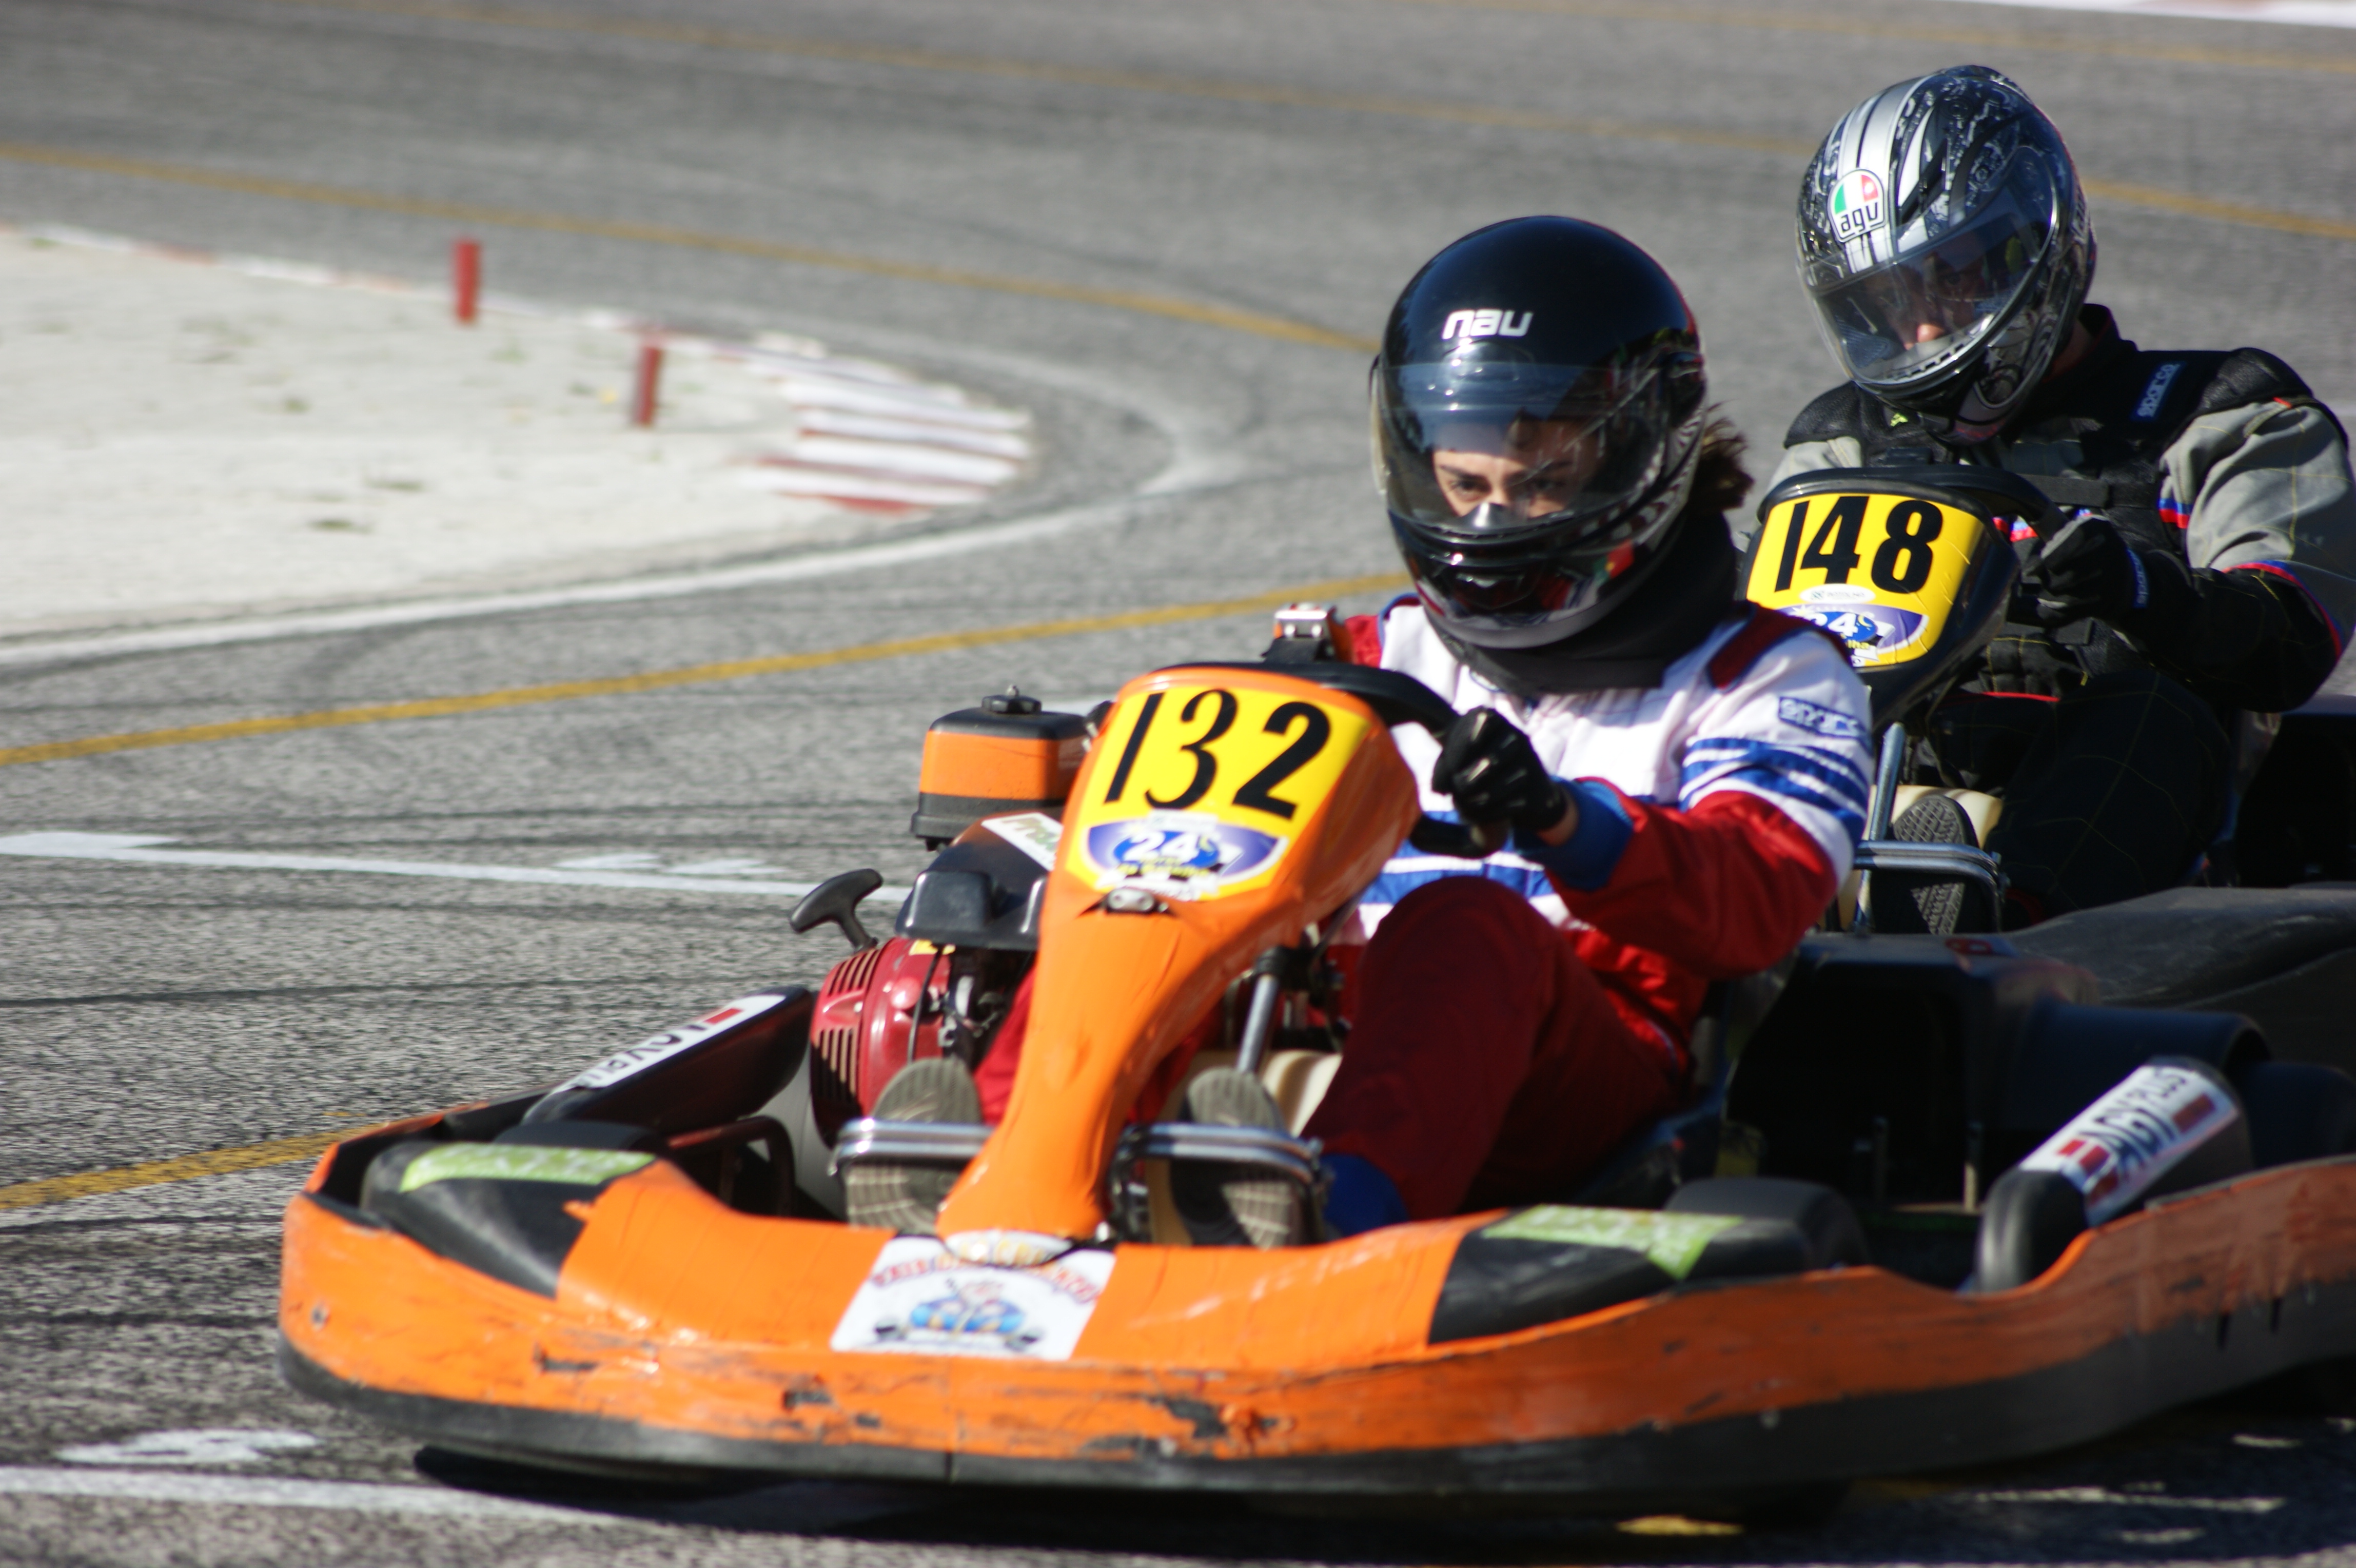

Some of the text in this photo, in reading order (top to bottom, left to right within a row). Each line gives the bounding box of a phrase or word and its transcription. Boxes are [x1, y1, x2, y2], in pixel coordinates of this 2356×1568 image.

[1839, 201, 1879, 236] agv
[1441, 308, 1534, 340] nau
[1774, 495, 1943, 595] 148
[1104, 689, 1331, 820] 132
[1122, 829, 1201, 864] 24
